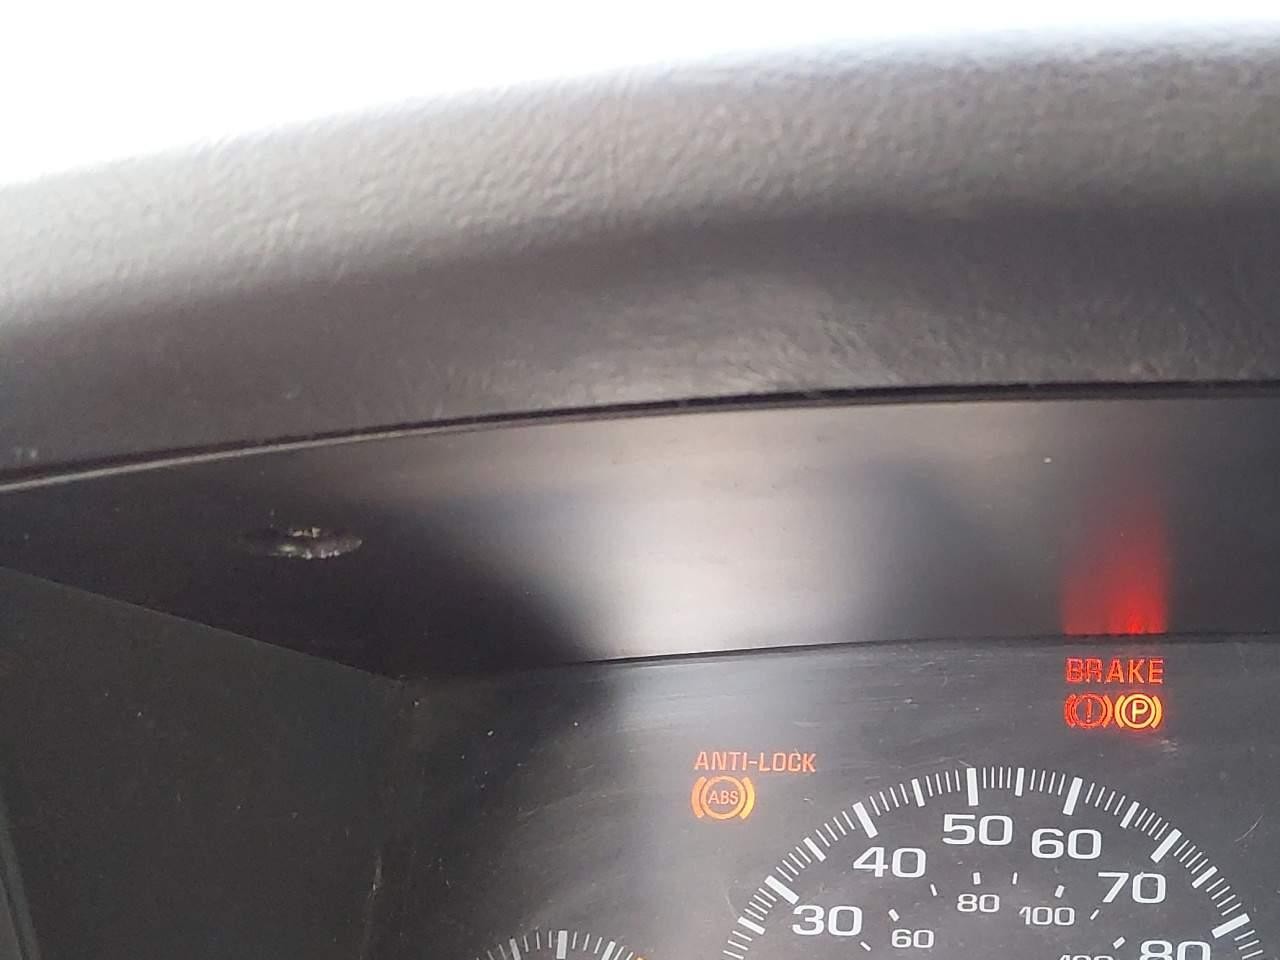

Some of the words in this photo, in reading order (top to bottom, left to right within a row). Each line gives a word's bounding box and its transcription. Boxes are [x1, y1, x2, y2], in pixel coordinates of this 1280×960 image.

[1066, 657, 1164, 683] BRAKE
[1132, 699, 1149, 722] P
[694, 751, 817, 773] ANTI-LOCK
[707, 790, 739, 805] ABS
[942, 814, 1013, 846] 50
[1032, 828, 1102, 860] 60
[853, 846, 927, 878] 40
[1098, 871, 1167, 904] 70
[956, 893, 1000, 912] 80
[792, 904, 863, 936] 30
[1019, 906, 1075, 926] 100
[891, 929, 934, 949] 60
